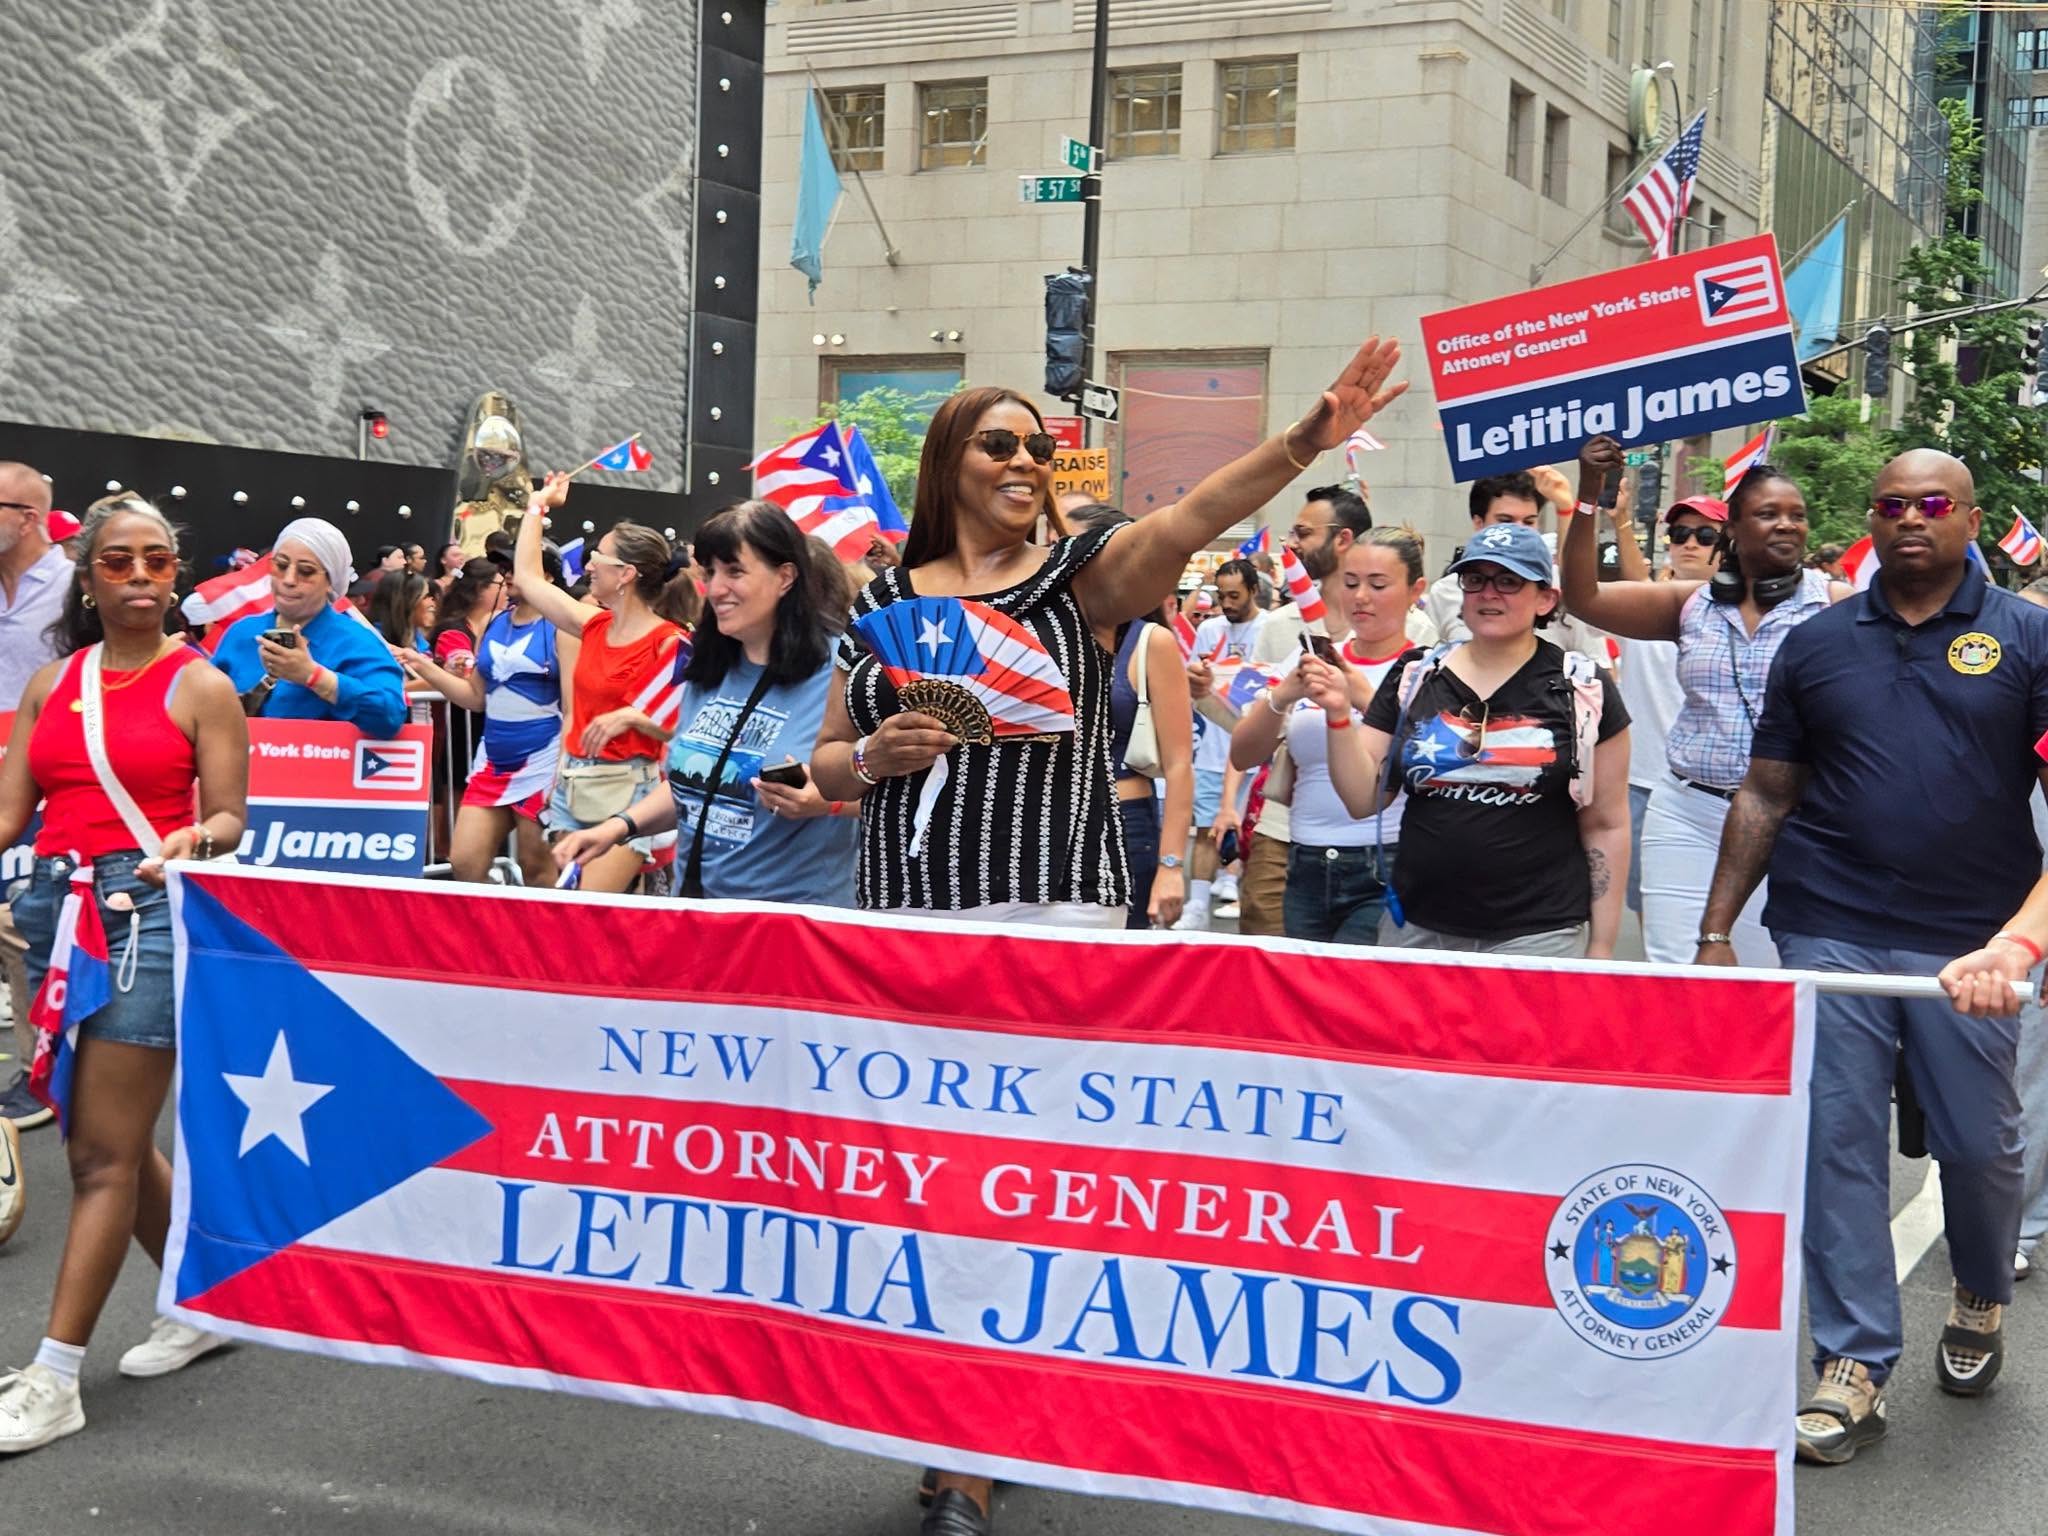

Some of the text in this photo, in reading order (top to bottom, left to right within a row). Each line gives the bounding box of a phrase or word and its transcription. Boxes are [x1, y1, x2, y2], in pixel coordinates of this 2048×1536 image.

[1072, 144, 1080, 164] 5
[1037, 180, 1044, 199] E
[1049, 180, 1066, 199] 57
[1436, 285, 1692, 354] Office of the New York State
[1441, 329, 1588, 376] Attoney General
[1456, 365, 1791, 463] Letitia James
[1053, 456, 1105, 472] RAISE
[258, 742, 300, 758] York
[303, 744, 351, 760] State
[254, 821, 417, 866] James
[599, 1026, 1346, 1145] NEW YORK STATE
[526, 1112, 1424, 1264] ATTORNEY GENERAL
[1566, 1175, 1721, 1238] STATE OF NEW YORK
[491, 1180, 1462, 1405] LETITIA JAMES
[1560, 1288, 1716, 1350] ATTORNEY GENERAL
